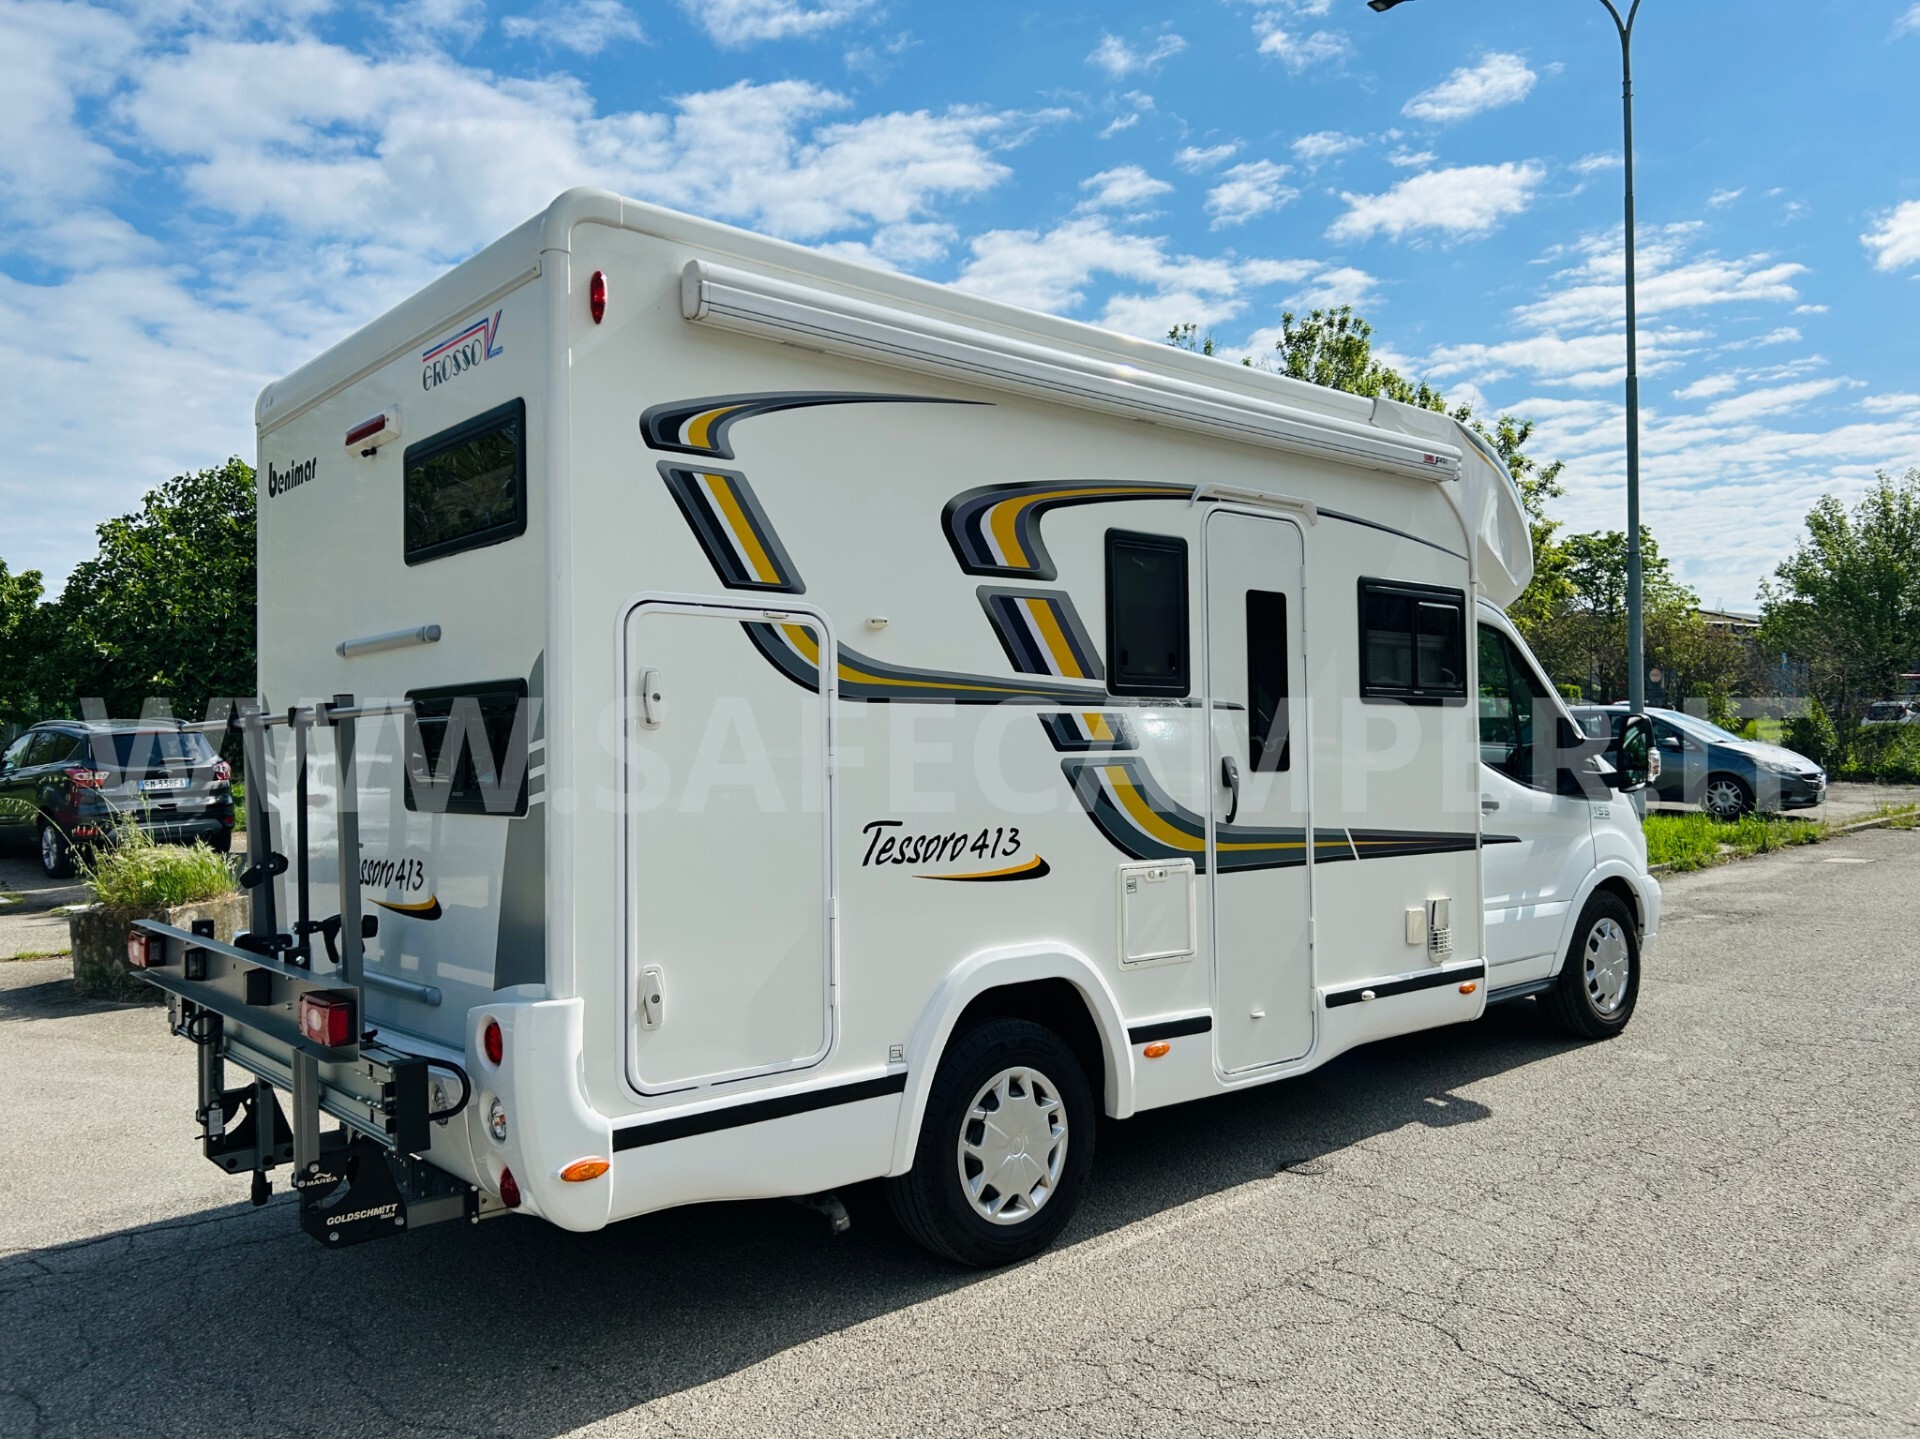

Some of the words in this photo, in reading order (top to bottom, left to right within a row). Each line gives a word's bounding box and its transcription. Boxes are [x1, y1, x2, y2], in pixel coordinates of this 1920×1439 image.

[422, 338, 482, 391] GROSSO
[268, 457, 316, 498] benimar
[1593, 806, 1610, 816] 155
[862, 820, 968, 866] Tessoro
[970, 827, 1021, 859] 413
[360, 858, 395, 888] ssoro
[395, 858, 424, 891] 413
[306, 1175, 338, 1187] MAREA
[326, 1203, 398, 1226] GOLDSCHMITT
